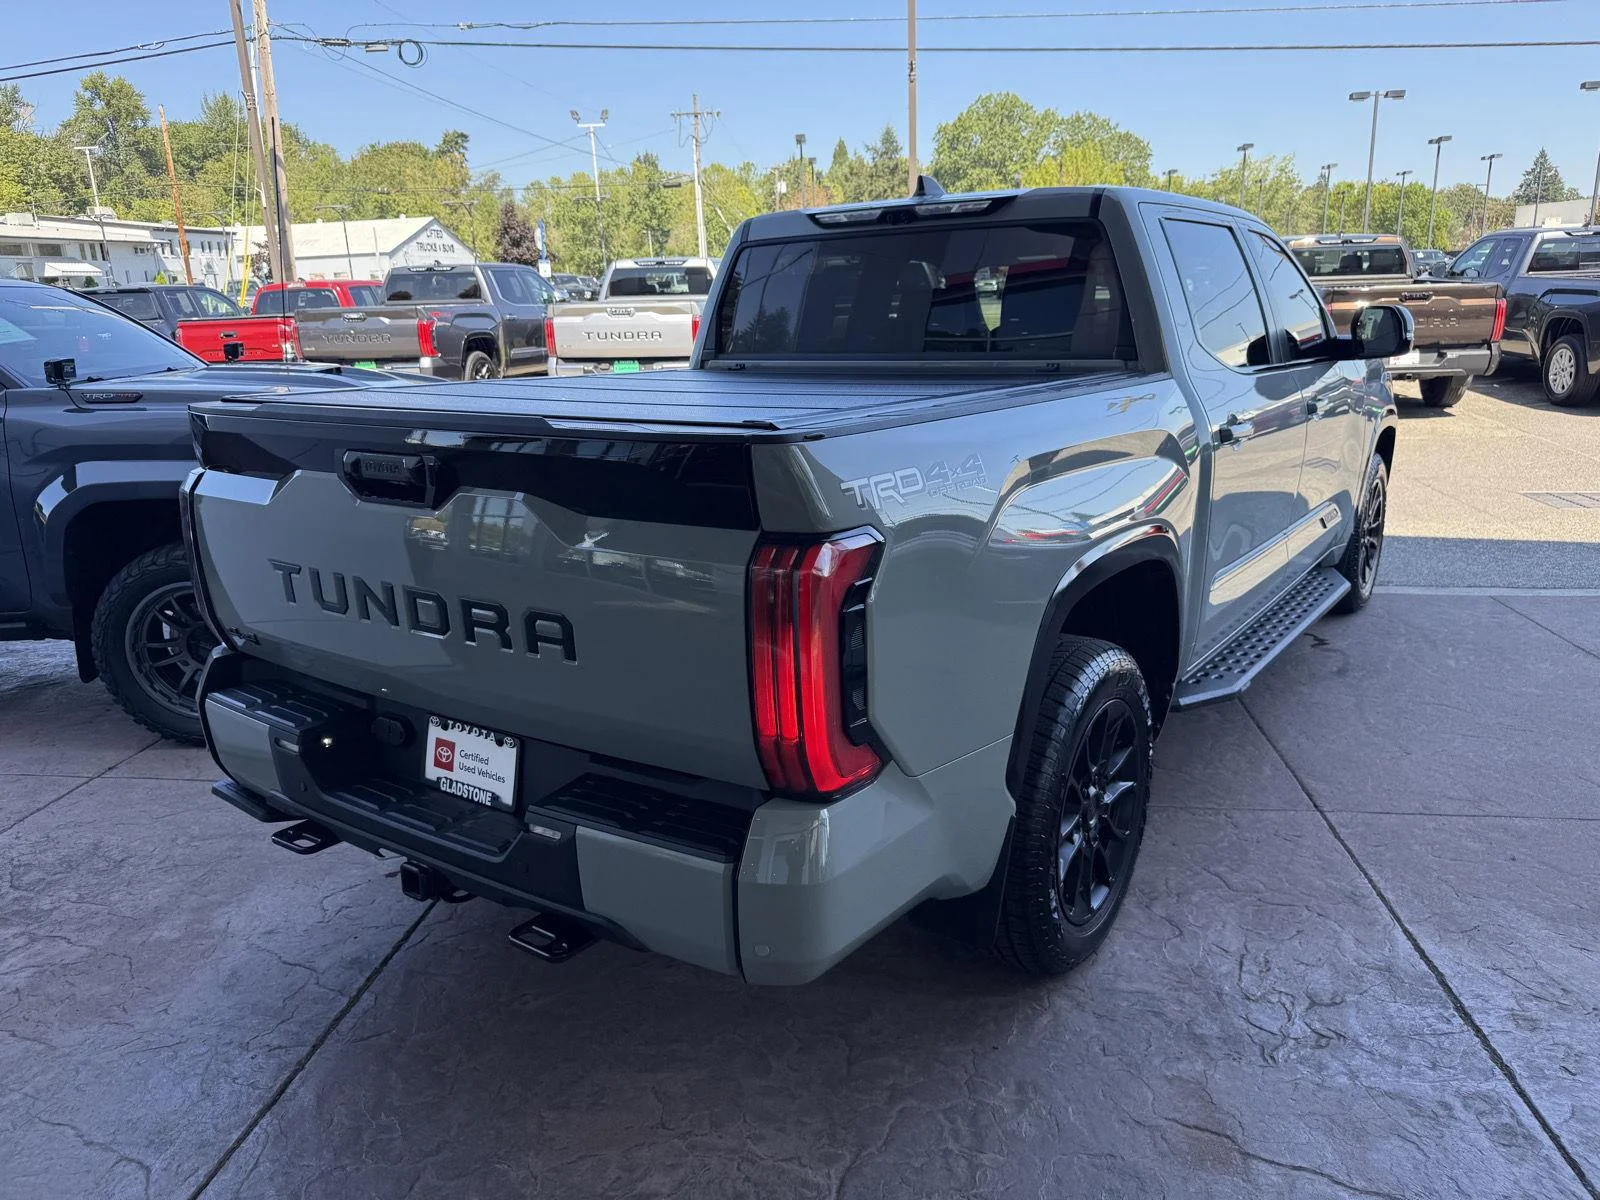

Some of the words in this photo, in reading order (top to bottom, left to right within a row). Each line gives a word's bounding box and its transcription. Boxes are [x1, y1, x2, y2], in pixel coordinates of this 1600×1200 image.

[322, 333, 392, 345] TUNDRA
[583, 330, 663, 341] TUNDRA
[840, 467, 928, 511] TRD
[269, 558, 578, 665] TUNDRA
[447, 719, 497, 743] TOYOTA
[459, 749, 490, 766] Certified
[458, 761, 476, 775] Used
[477, 767, 506, 784] Vehicles
[440, 777, 493, 806] GLADSTONE
